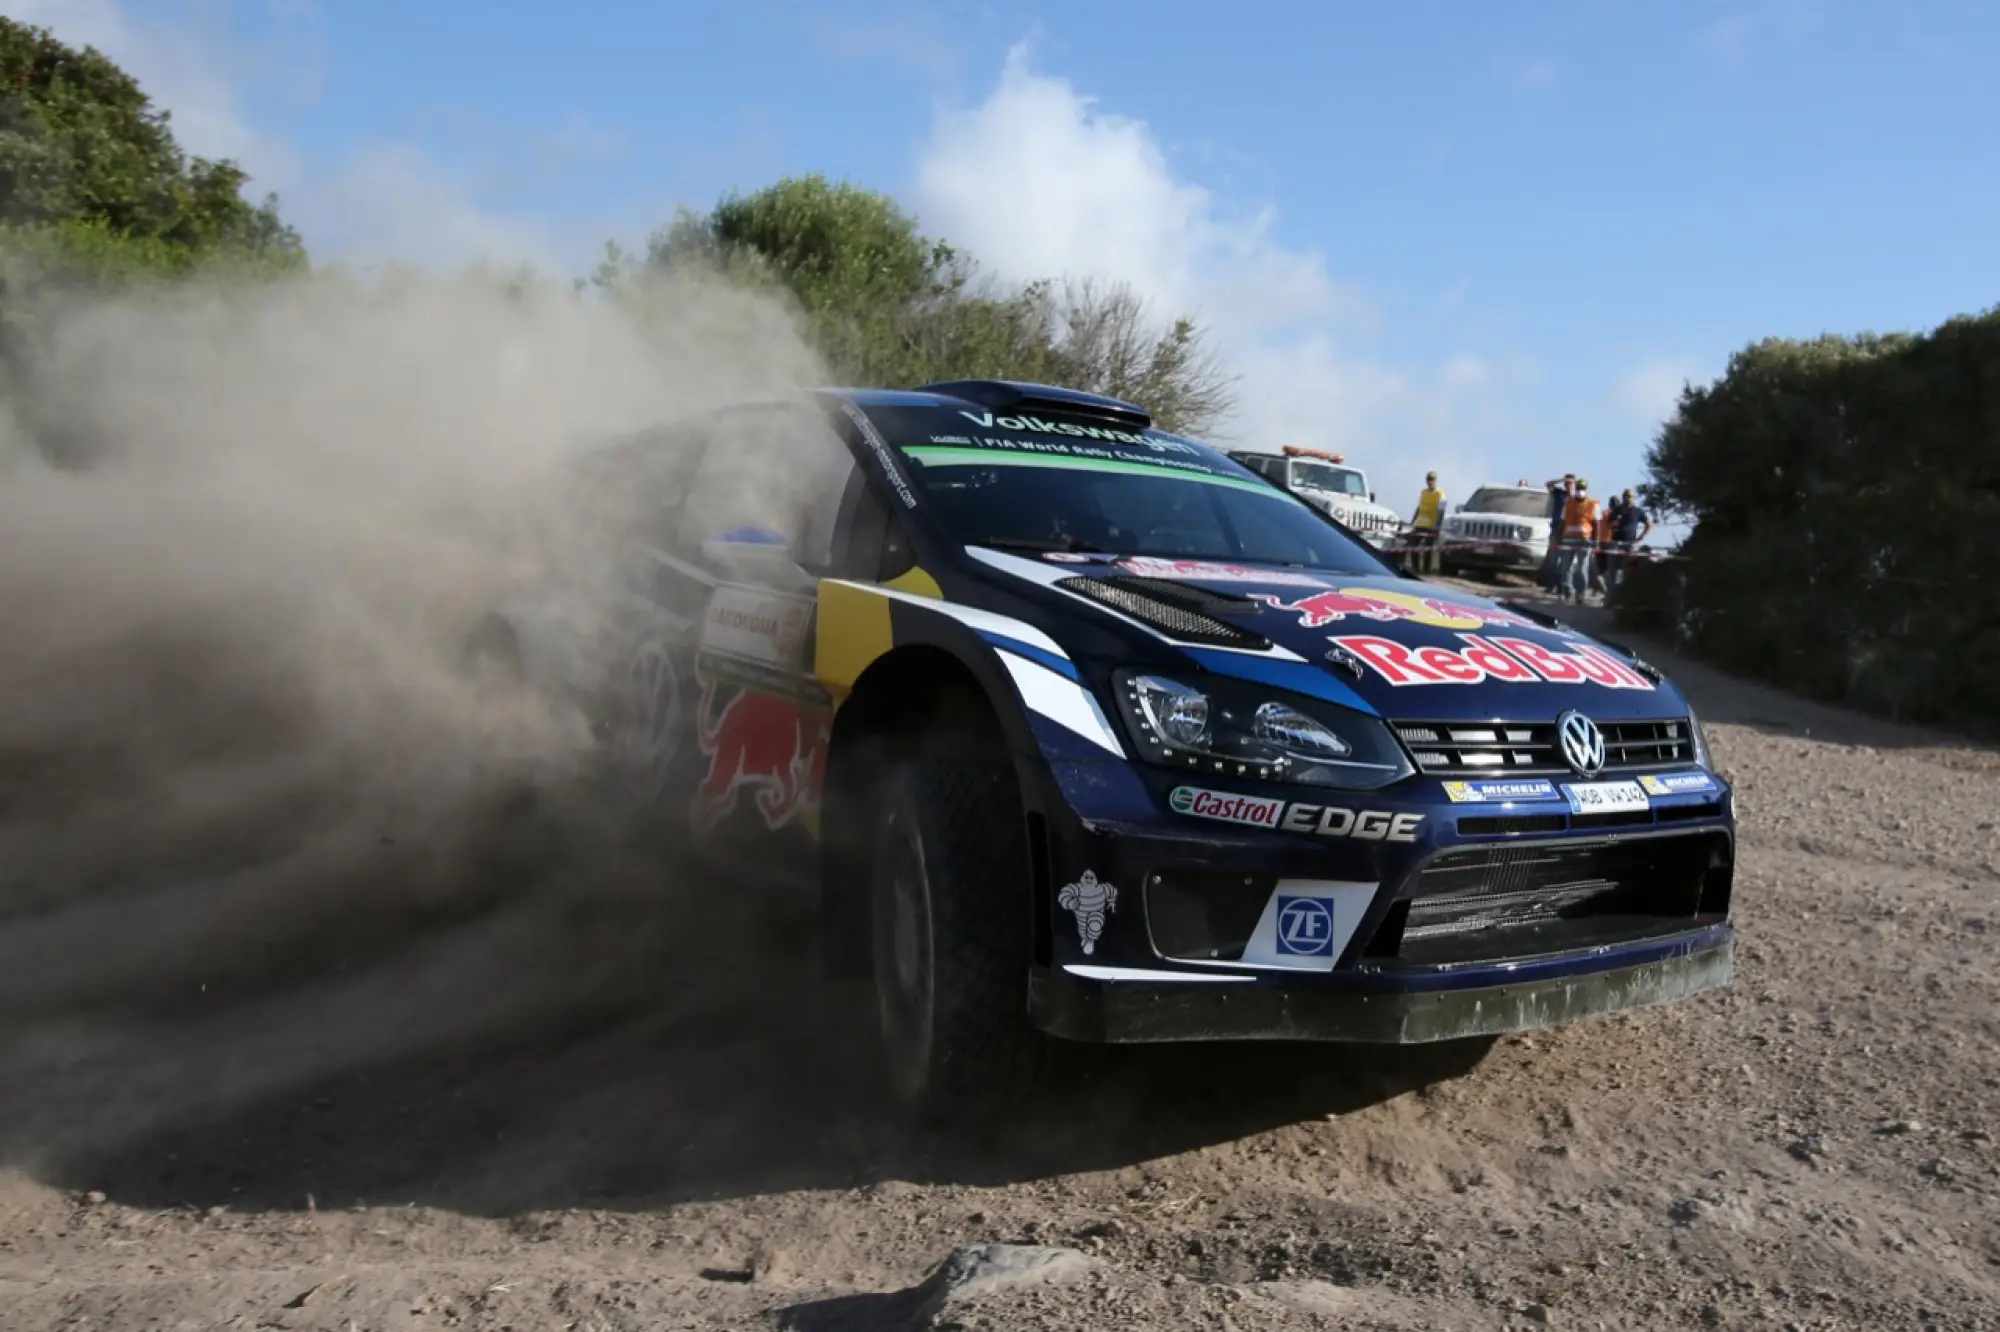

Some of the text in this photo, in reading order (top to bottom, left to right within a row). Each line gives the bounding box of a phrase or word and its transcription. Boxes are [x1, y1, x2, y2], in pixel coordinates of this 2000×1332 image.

[1481, 782, 1552, 797] MICHELIN
[1192, 791, 1426, 843] Castrol EDGE
[1285, 909, 1323, 943] ZF
